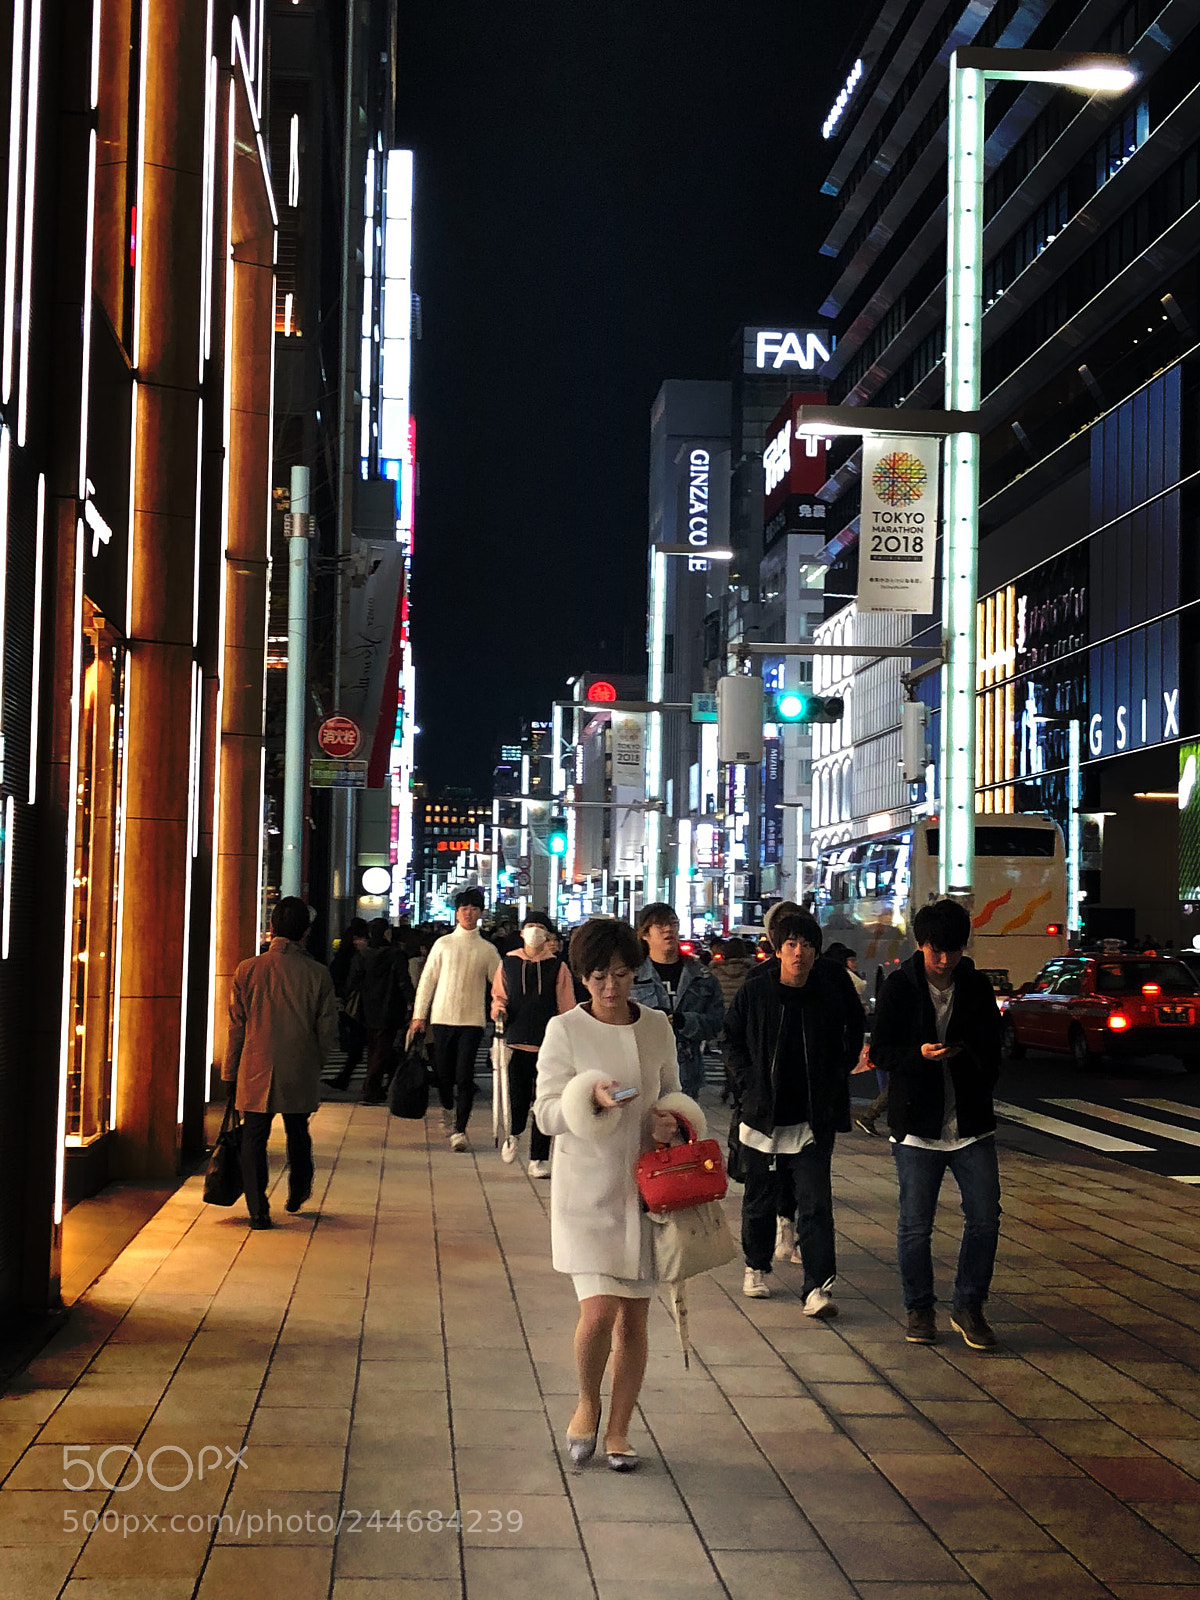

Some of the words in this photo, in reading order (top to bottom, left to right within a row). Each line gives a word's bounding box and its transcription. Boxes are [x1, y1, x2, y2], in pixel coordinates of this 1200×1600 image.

[688, 449, 710, 514] GINZA
[872, 511, 925, 524] TOKYO
[872, 526, 924, 534] MARATHON
[688, 516, 709, 572] COE
[870, 536, 924, 553] 2018
[322, 728, 357, 746] 消火栓
